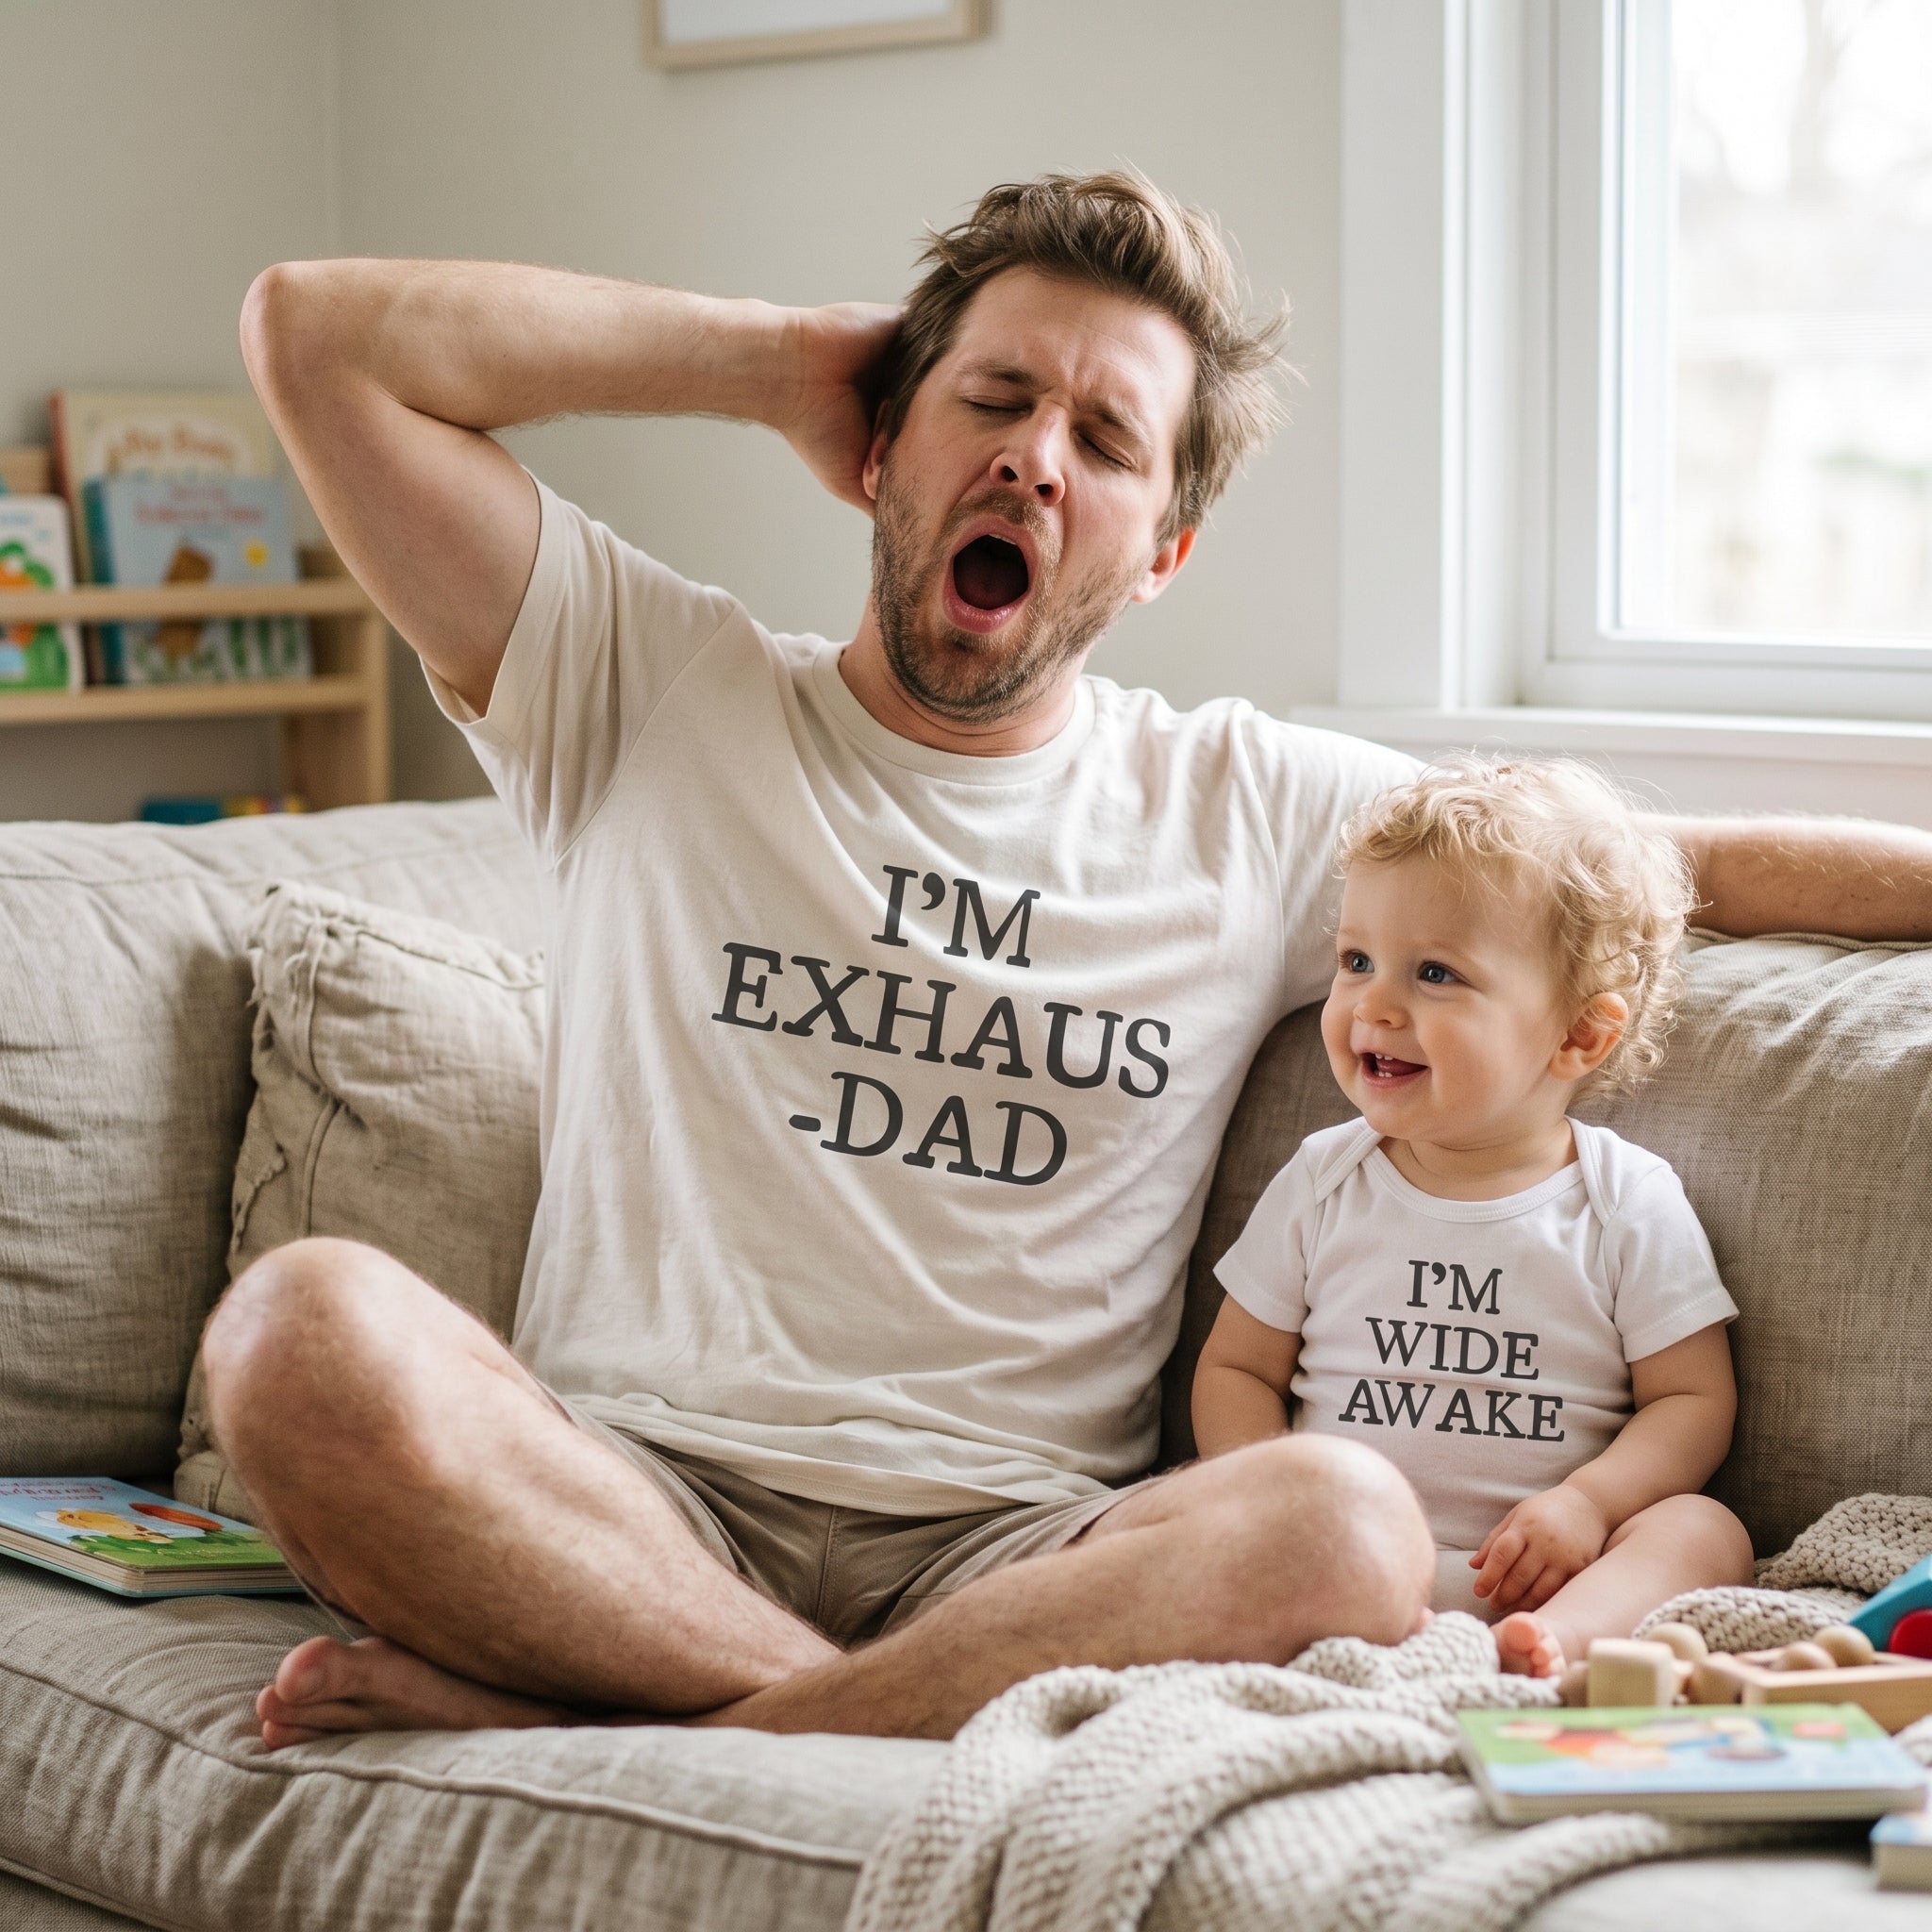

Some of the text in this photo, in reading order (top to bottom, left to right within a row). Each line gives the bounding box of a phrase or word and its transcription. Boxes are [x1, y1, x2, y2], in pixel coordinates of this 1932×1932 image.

[871, 864, 1041, 969] I’M
[711, 941, 1171, 1099] EXHAUS
[788, 1071, 1068, 1186] -DAD
[1406, 1259, 1503, 1315] I’M
[1365, 1316, 1539, 1380] WIDE
[1338, 1378, 1565, 1442] AWAKE
